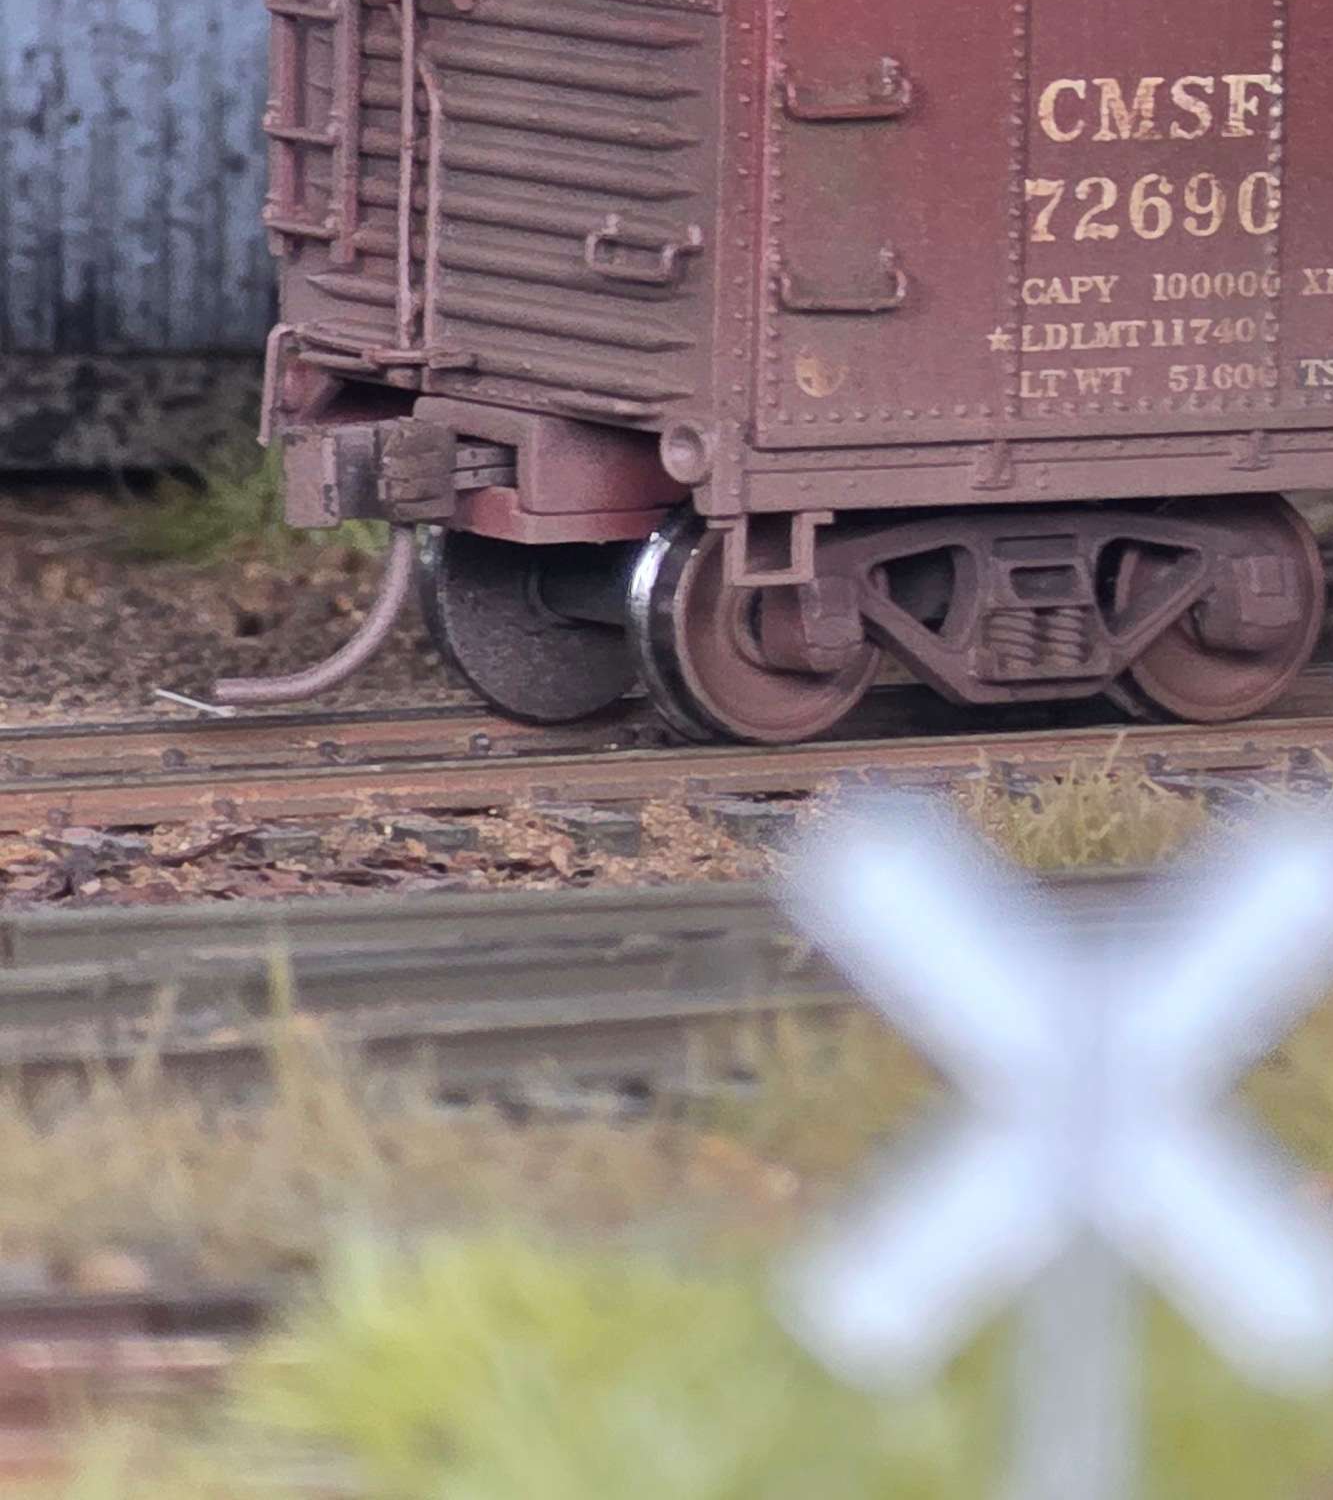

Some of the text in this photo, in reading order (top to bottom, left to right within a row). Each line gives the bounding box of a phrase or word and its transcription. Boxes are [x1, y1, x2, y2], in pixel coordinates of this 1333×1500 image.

[1037, 73, 1279, 143] CMSF
[1024, 170, 1282, 243] 72690
[1020, 274, 1120, 306] CAPY
[1152, 269, 1281, 302] 100000
